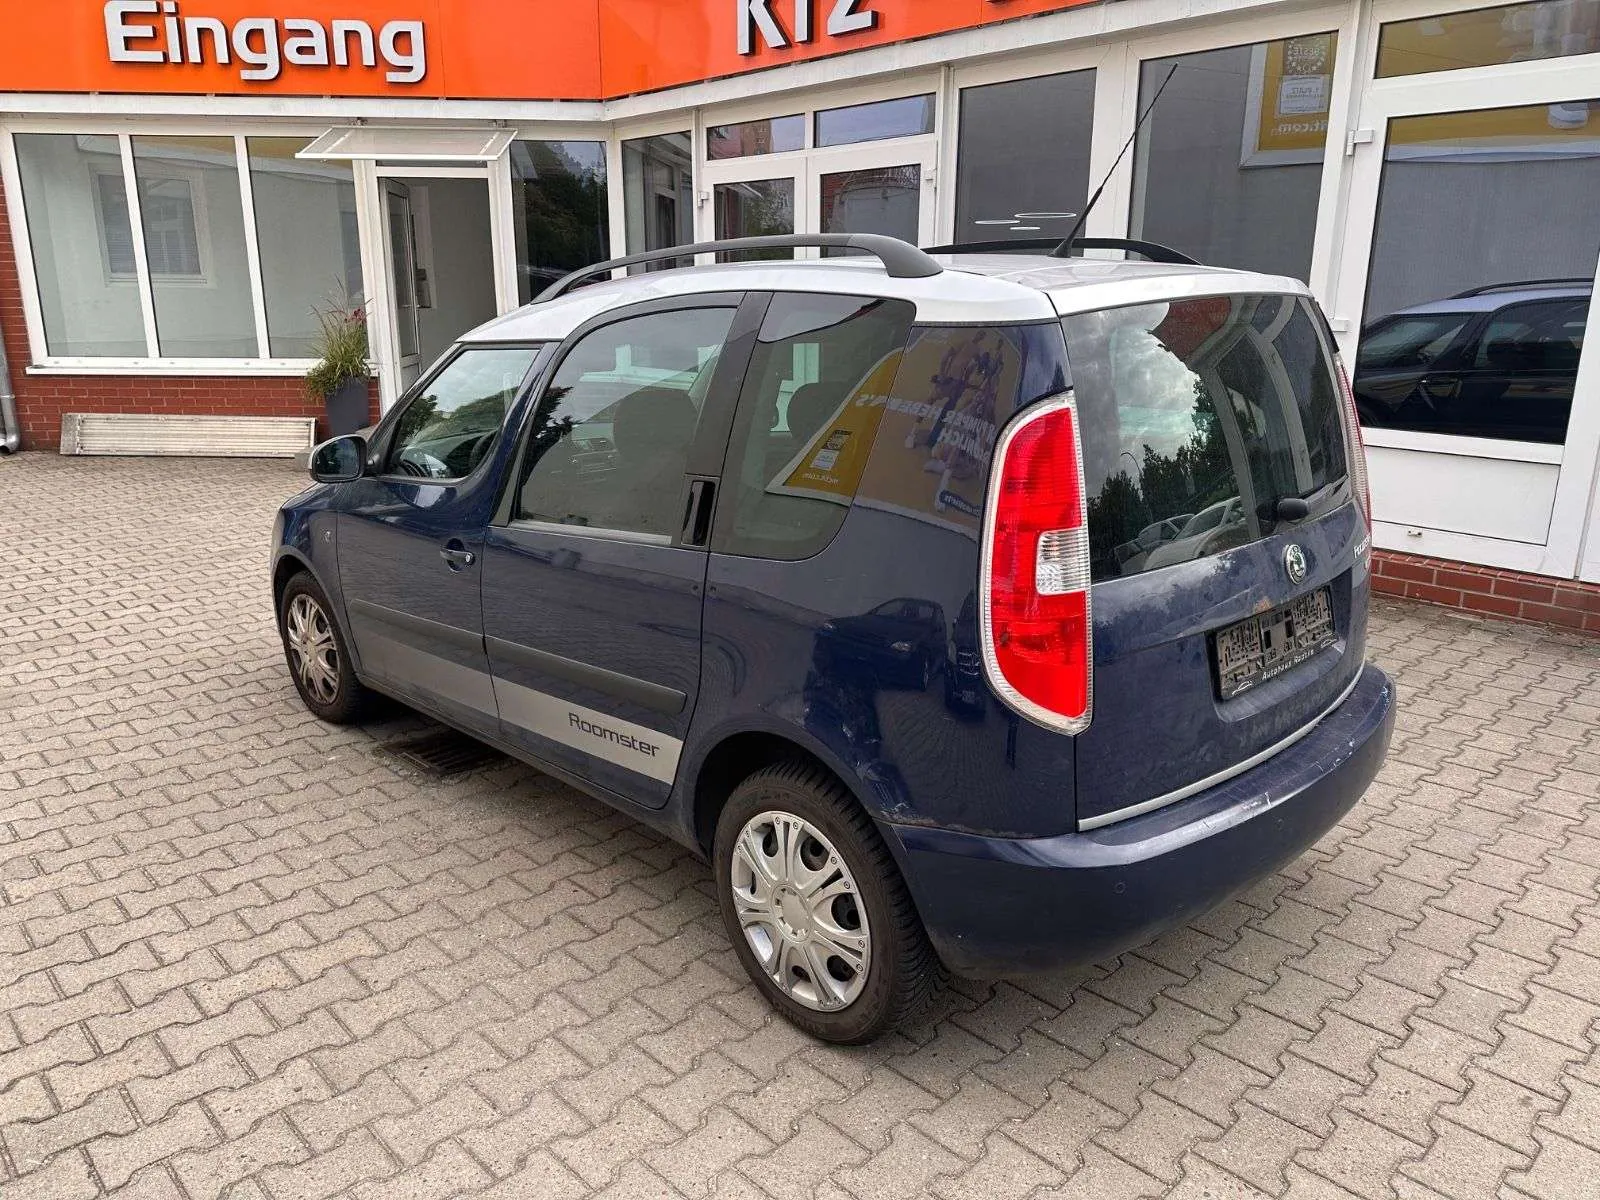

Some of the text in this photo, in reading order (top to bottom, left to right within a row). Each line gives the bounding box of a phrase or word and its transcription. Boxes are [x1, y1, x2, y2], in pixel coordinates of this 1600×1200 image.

[103, 0, 426, 83] Eingang
[1261, 660, 1292, 681] Autohaus
[568, 712, 661, 757] Roomster
